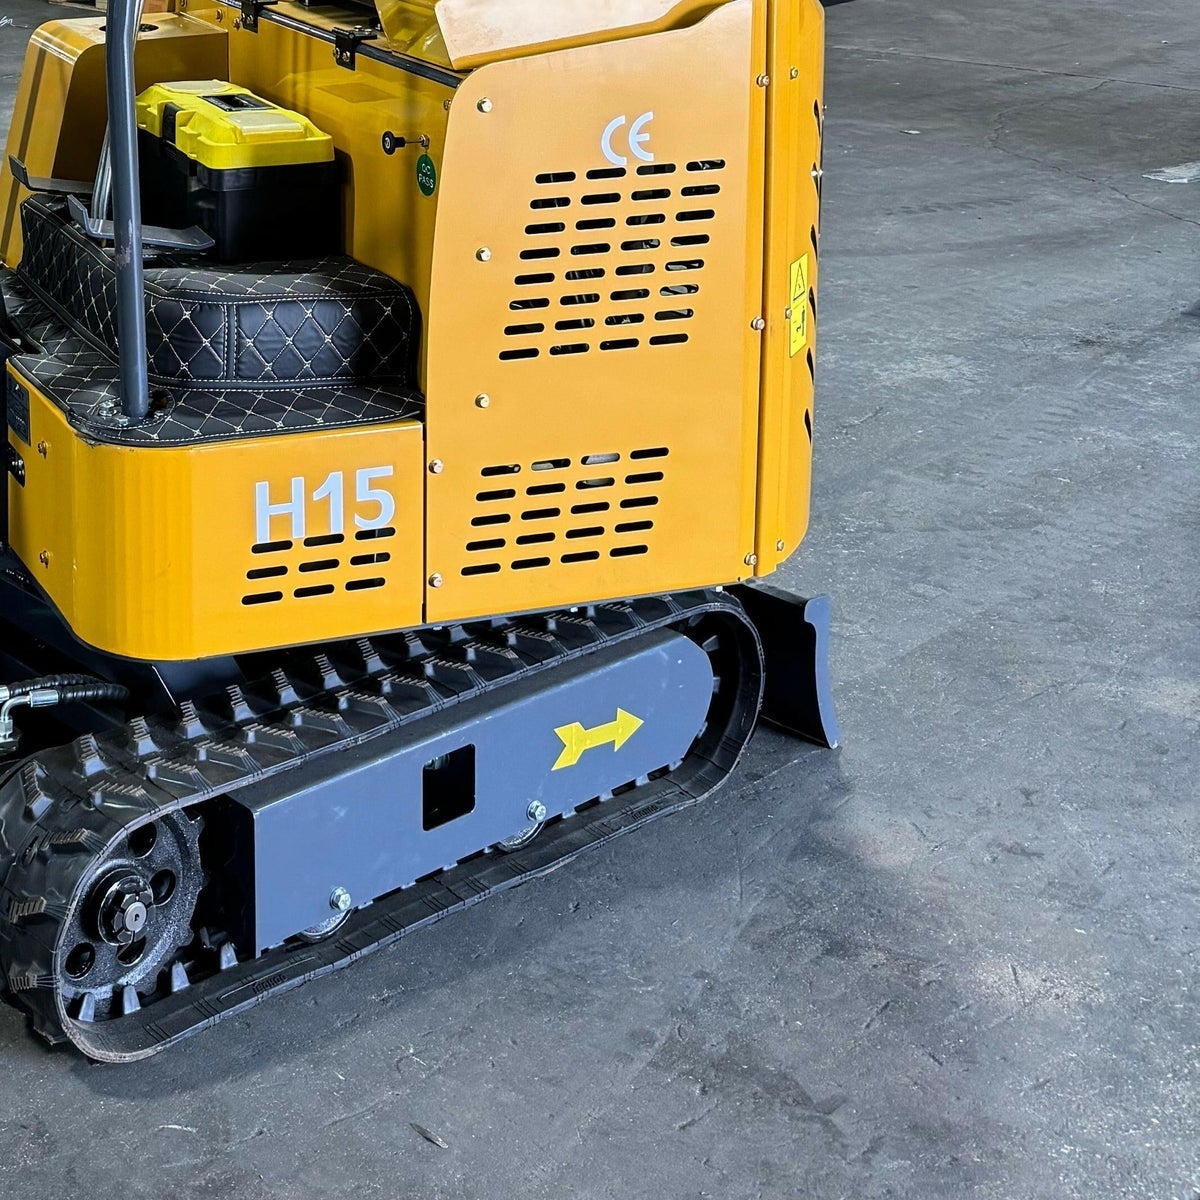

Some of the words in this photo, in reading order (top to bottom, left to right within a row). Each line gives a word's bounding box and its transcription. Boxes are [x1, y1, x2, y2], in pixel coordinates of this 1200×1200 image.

[601, 111, 654, 166] CE
[418, 173, 434, 189] PASS
[255, 465, 396, 544] H15
